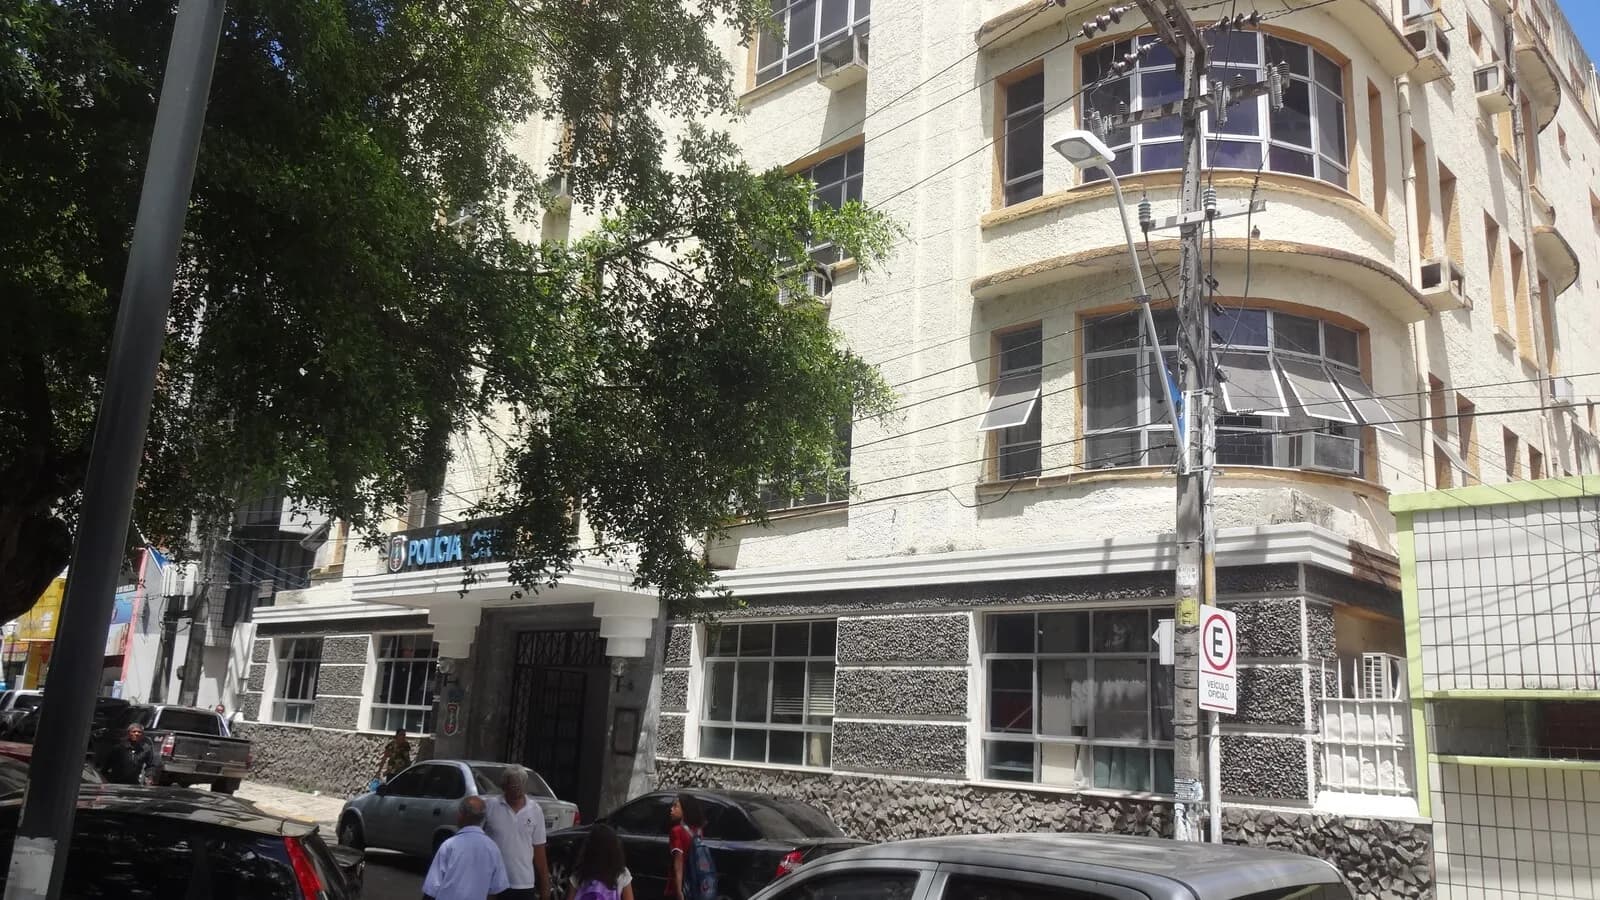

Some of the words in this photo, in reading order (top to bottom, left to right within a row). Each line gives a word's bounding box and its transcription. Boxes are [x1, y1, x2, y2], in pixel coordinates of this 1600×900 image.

[408, 529, 462, 566] POLÍCIA
[1213, 627, 1223, 658] E
[1207, 680, 1229, 691] VEÍCULO
[1208, 690, 1228, 700] OFICIAL
